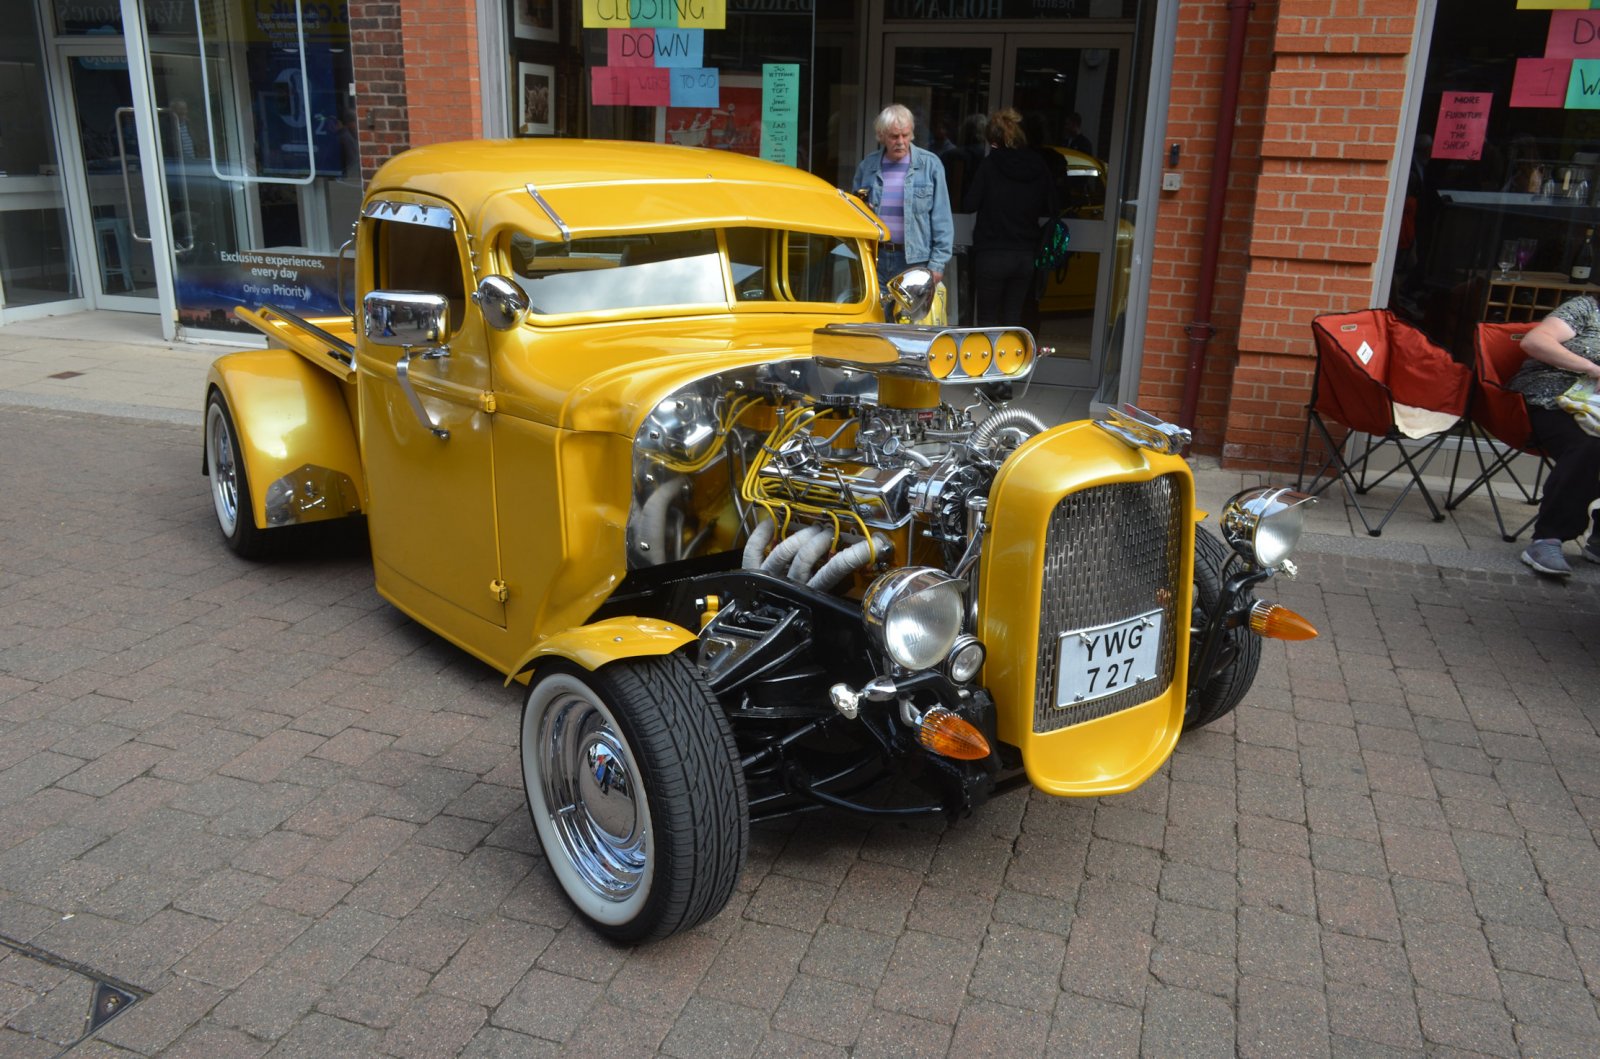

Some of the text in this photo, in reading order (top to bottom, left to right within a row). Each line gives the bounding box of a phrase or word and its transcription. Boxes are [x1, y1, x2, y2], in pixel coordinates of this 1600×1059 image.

[621, 33, 689, 58] DOWN
[680, 75, 696, 89] TO
[698, 74, 717, 88] GO
[221, 251, 325, 270] Exclusive experiences,
[251, 267, 298, 281] every day
[243, 284, 306, 300] Only on Priority
[1085, 625, 1143, 661] YWG
[1087, 658, 1134, 692] 727
